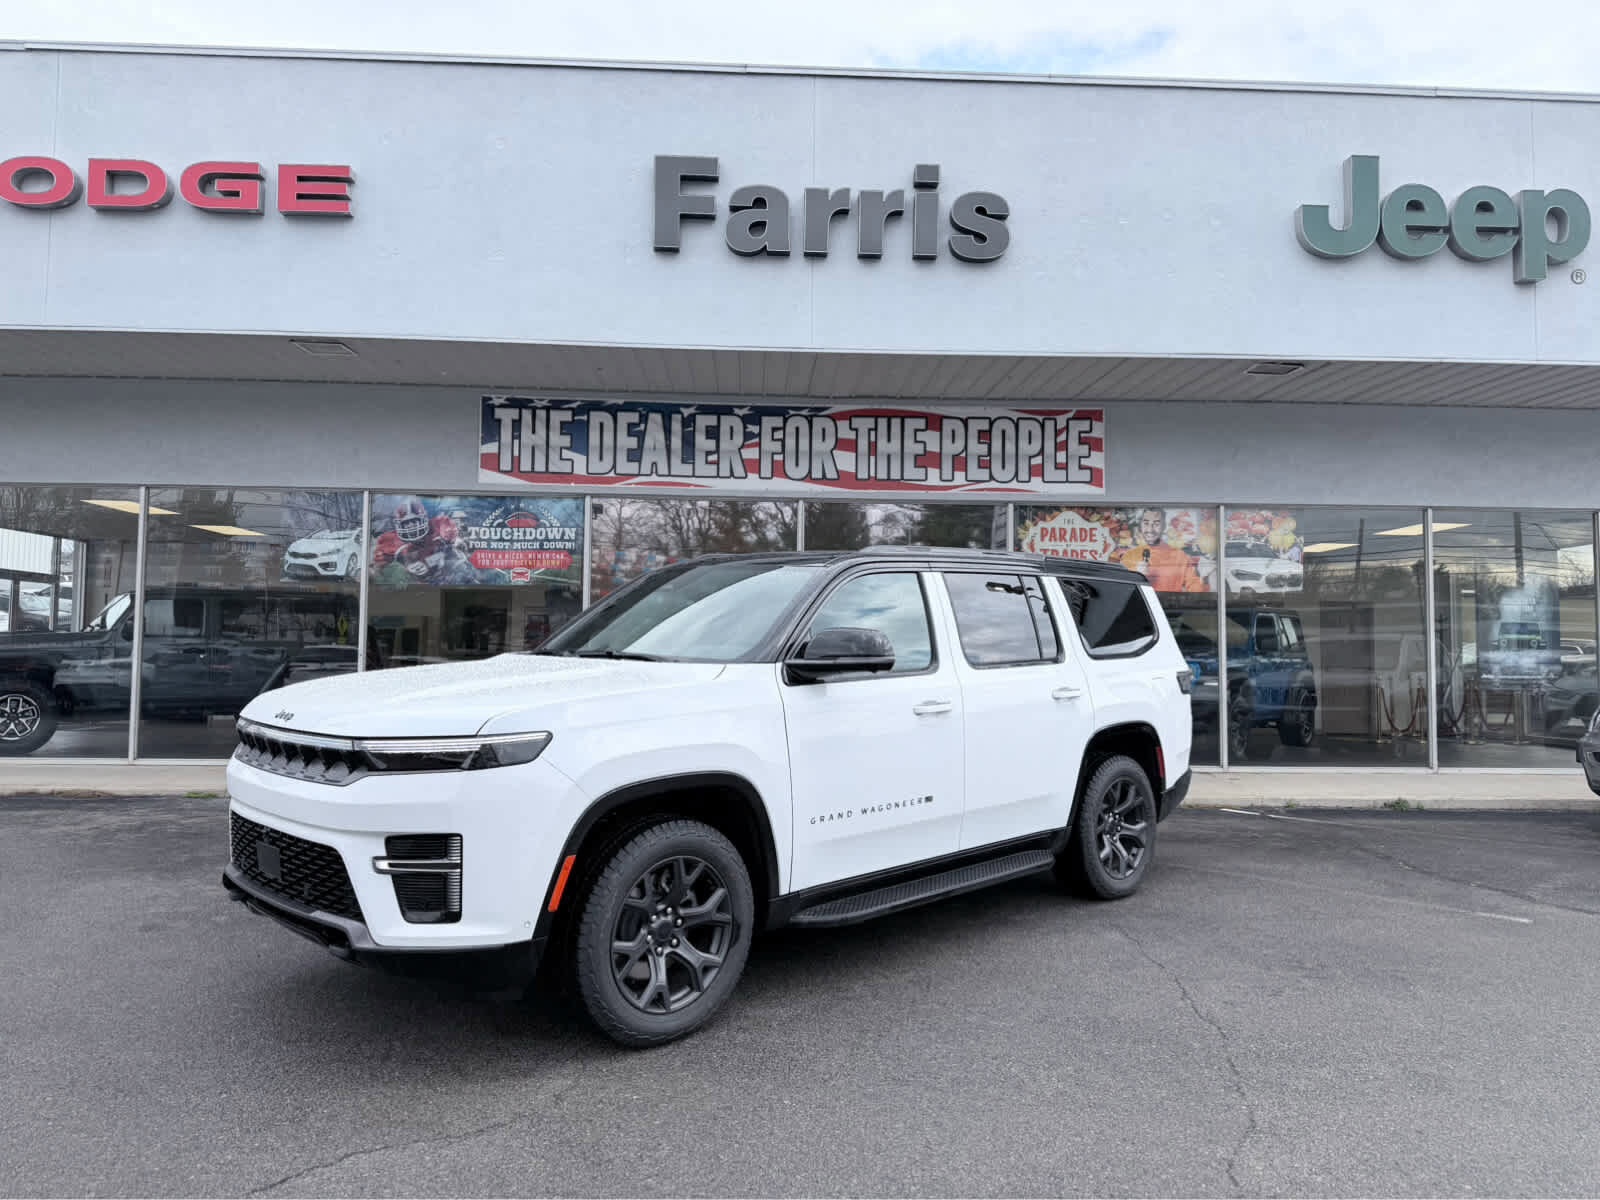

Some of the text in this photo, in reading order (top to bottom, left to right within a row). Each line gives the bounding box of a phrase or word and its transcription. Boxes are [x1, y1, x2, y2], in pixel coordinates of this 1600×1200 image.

[653, 155, 1010, 263] Farris
[1294, 154, 1591, 285] Jeep
[493, 407, 1093, 483] THE DEALER FOR THE PEOPLE
[467, 526, 577, 540] TOUCHDOWN
[469, 541, 488, 549] FOR
[490, 541, 509, 549] NOT
[512, 541, 540, 549] MUCH
[1040, 526, 1098, 543] PARADE
[810, 796, 923, 825] GRAND WAGONEER
